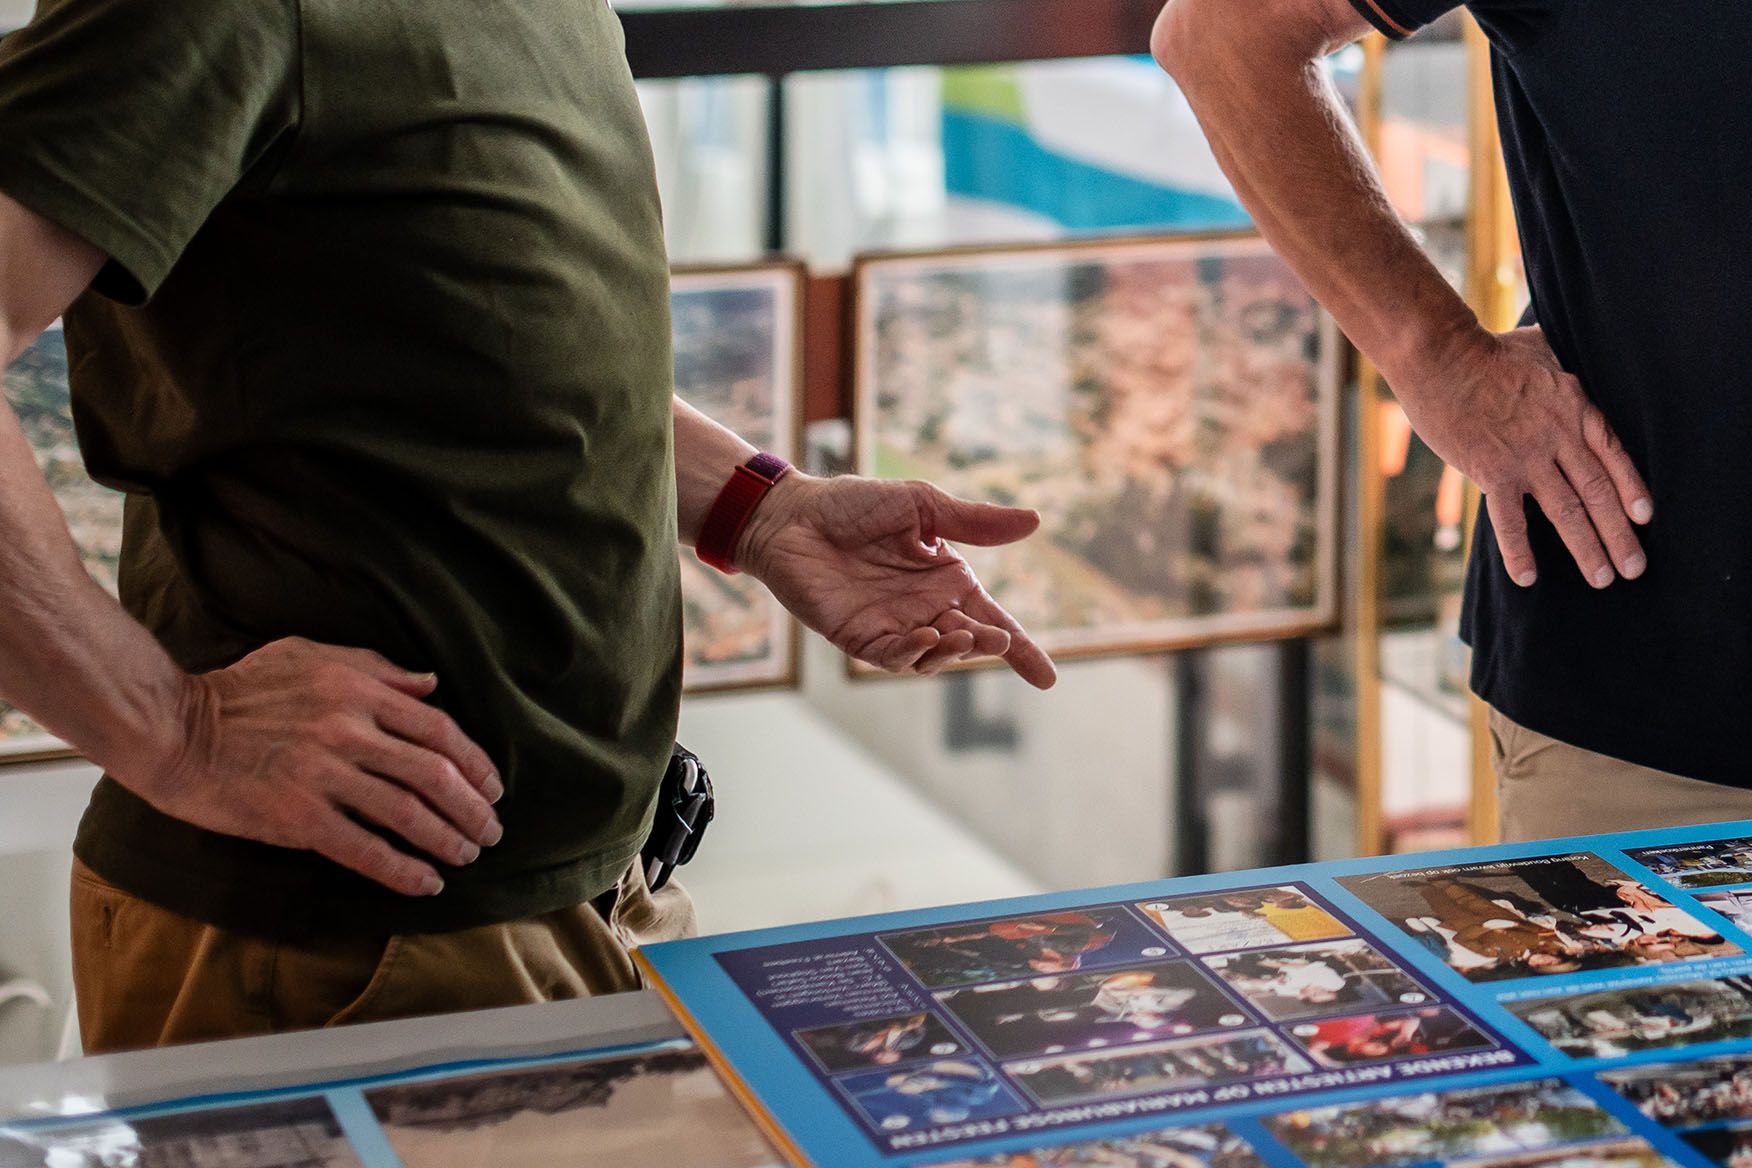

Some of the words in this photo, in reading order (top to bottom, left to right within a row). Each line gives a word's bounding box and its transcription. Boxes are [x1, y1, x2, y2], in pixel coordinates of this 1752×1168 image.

[1461, 863, 1496, 872] kwam
[1496, 859, 1550, 869] Boudewijn
[1551, 854, 1589, 863] Koning
[1396, 1048, 1517, 1076] BEKENDE
[1212, 1081, 1250, 1103] OP
[1254, 1063, 1394, 1097] ARTIESTEN
[1012, 1087, 1210, 1129] MARIABURGSE
[888, 1118, 1011, 1150] FEESTEN
